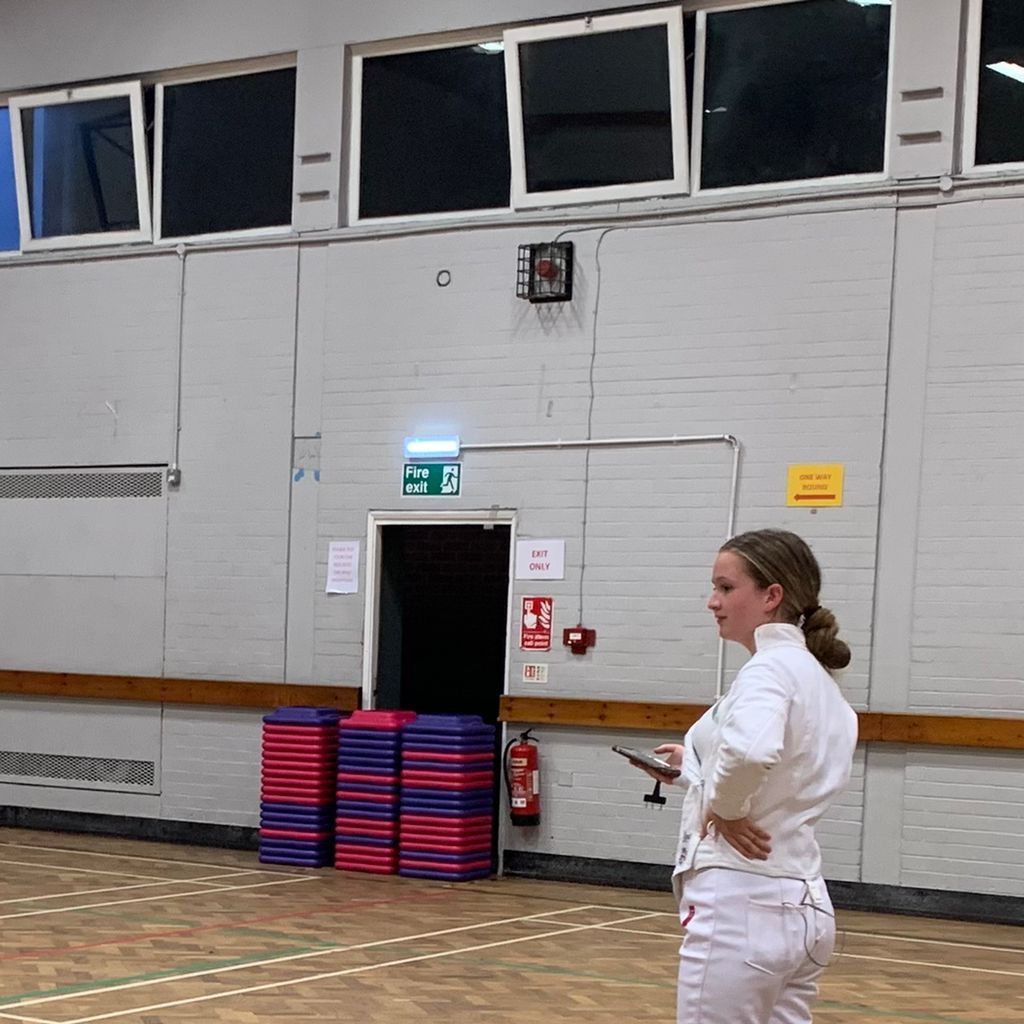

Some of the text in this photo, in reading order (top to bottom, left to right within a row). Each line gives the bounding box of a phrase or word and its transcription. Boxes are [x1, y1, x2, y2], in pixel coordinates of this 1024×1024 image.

[405, 466, 429, 479] Fire
[405, 481, 428, 493] exit
[532, 550, 549, 558] EXIT
[529, 563, 551, 571] ONLY
